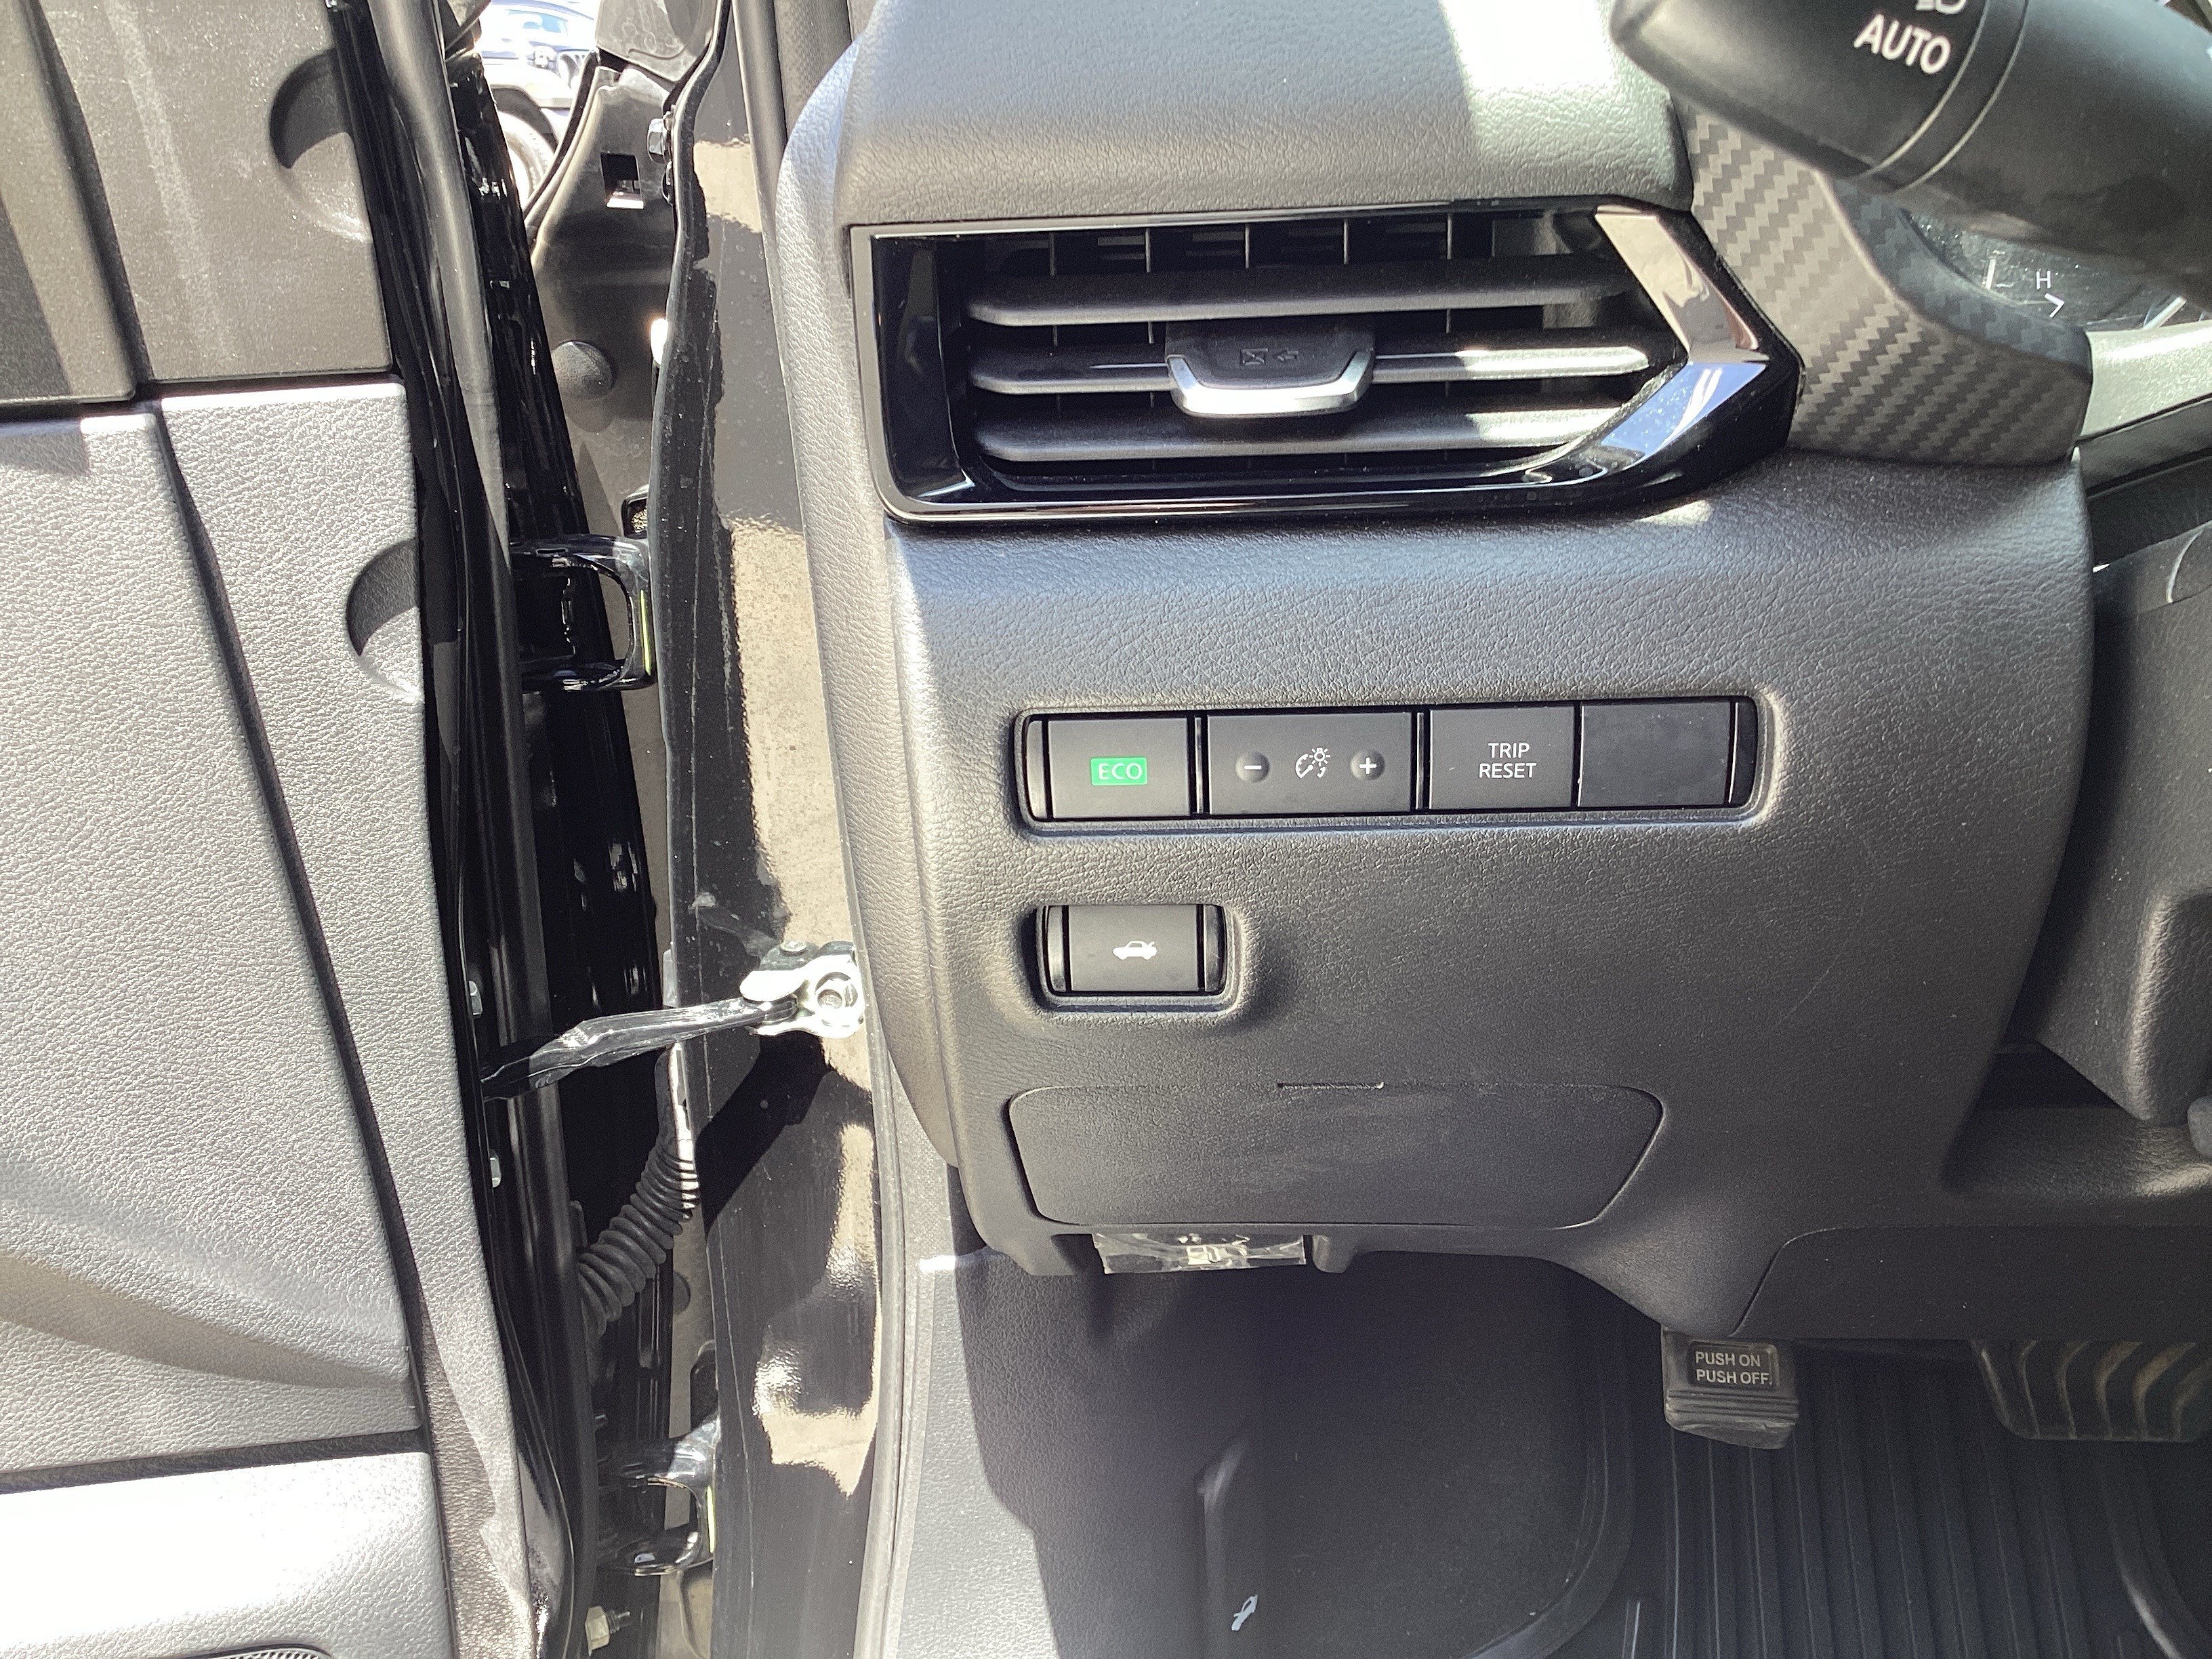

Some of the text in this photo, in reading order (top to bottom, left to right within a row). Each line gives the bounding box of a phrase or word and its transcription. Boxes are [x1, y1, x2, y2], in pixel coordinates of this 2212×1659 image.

[1853, 14, 1950, 74] AUTO
[2036, 270, 2051, 289] H
[1488, 742, 1530, 758] TRIP
[1099, 762, 1143, 780] ECO
[1479, 762, 1537, 778] RESET
[1696, 1351, 1760, 1367] PUSH ON
[1696, 1369, 1769, 1385] PUSH OFF
